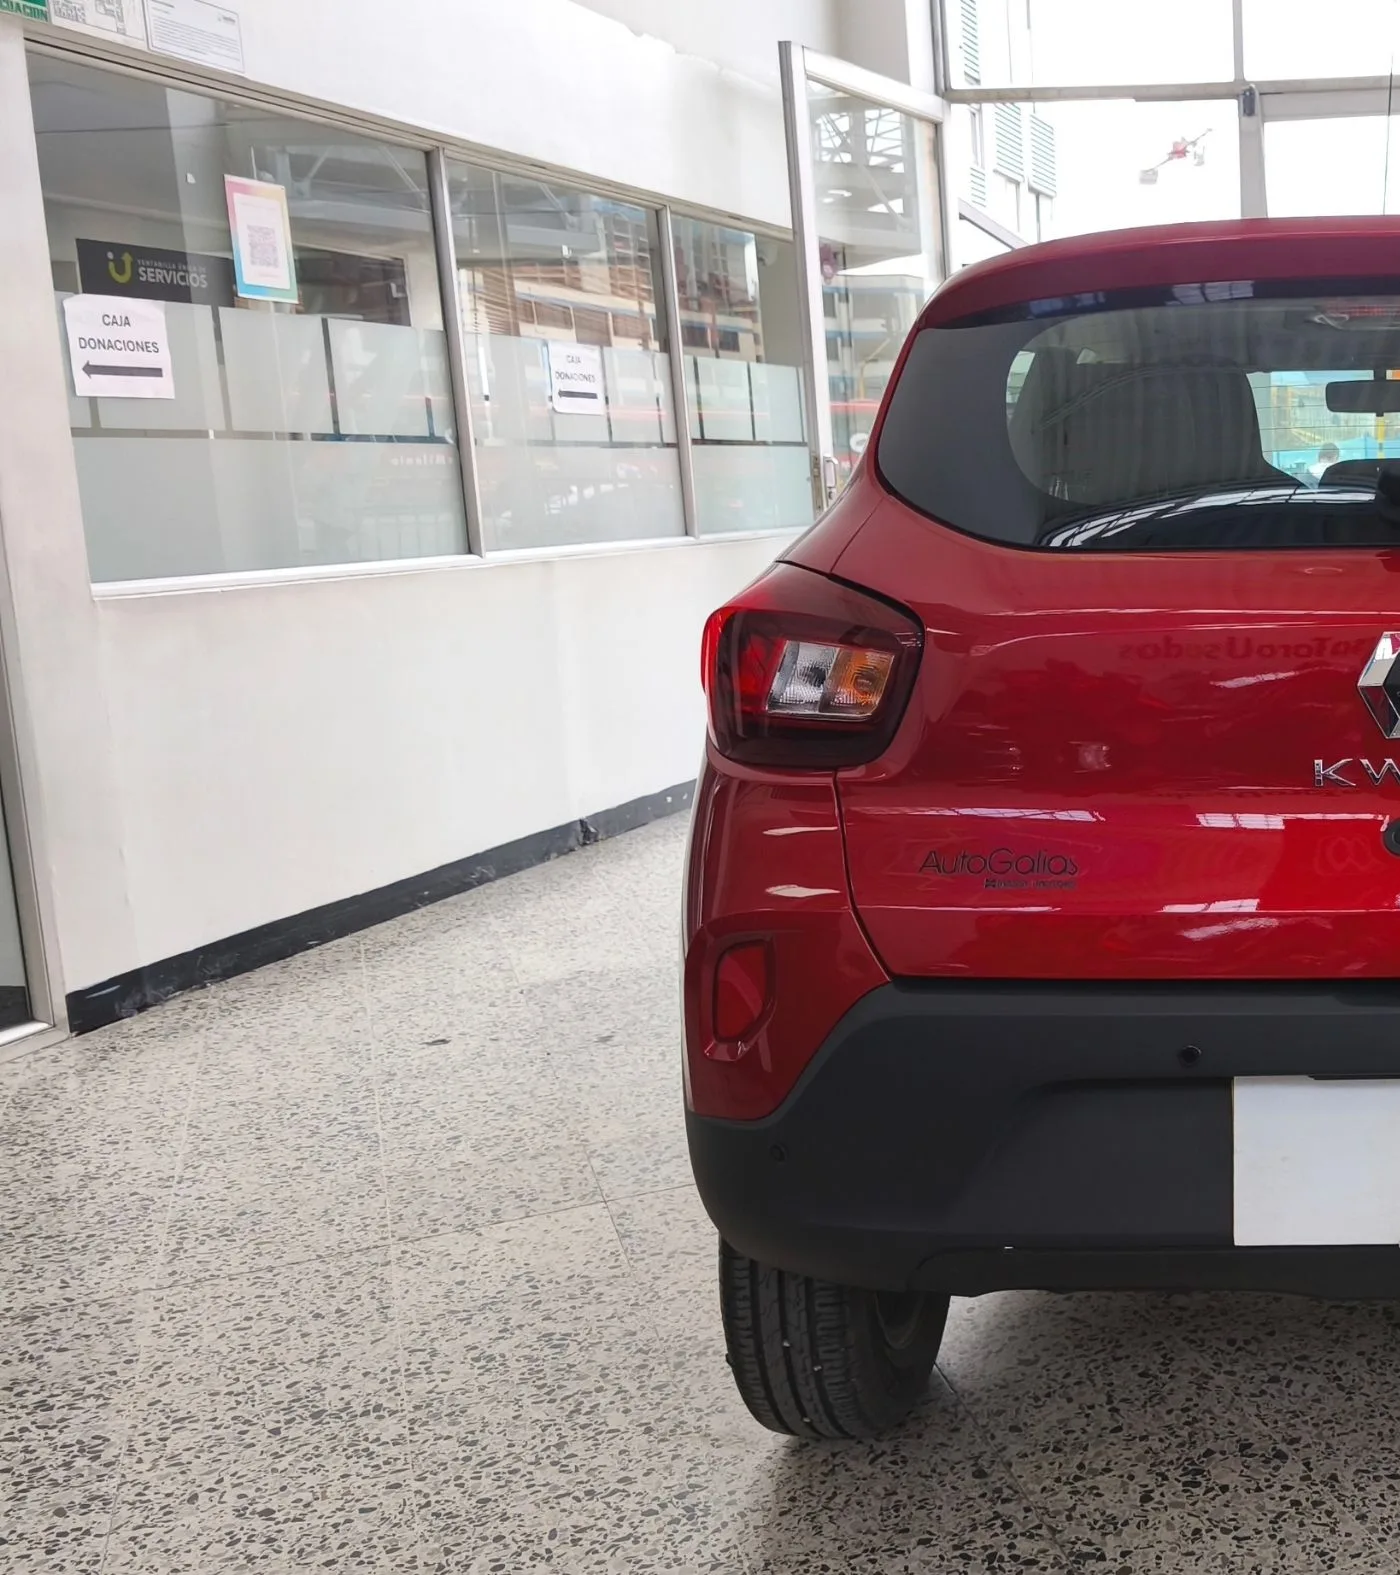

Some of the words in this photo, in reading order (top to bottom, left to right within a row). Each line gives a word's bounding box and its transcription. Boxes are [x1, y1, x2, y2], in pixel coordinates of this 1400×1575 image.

[138, 266, 208, 288] SERVICIOS
[102, 314, 131, 327] CAJA
[79, 337, 159, 353] DONACIONES
[555, 371, 595, 383] DONACIONES
[918, 847, 1078, 875] AutoGalias
